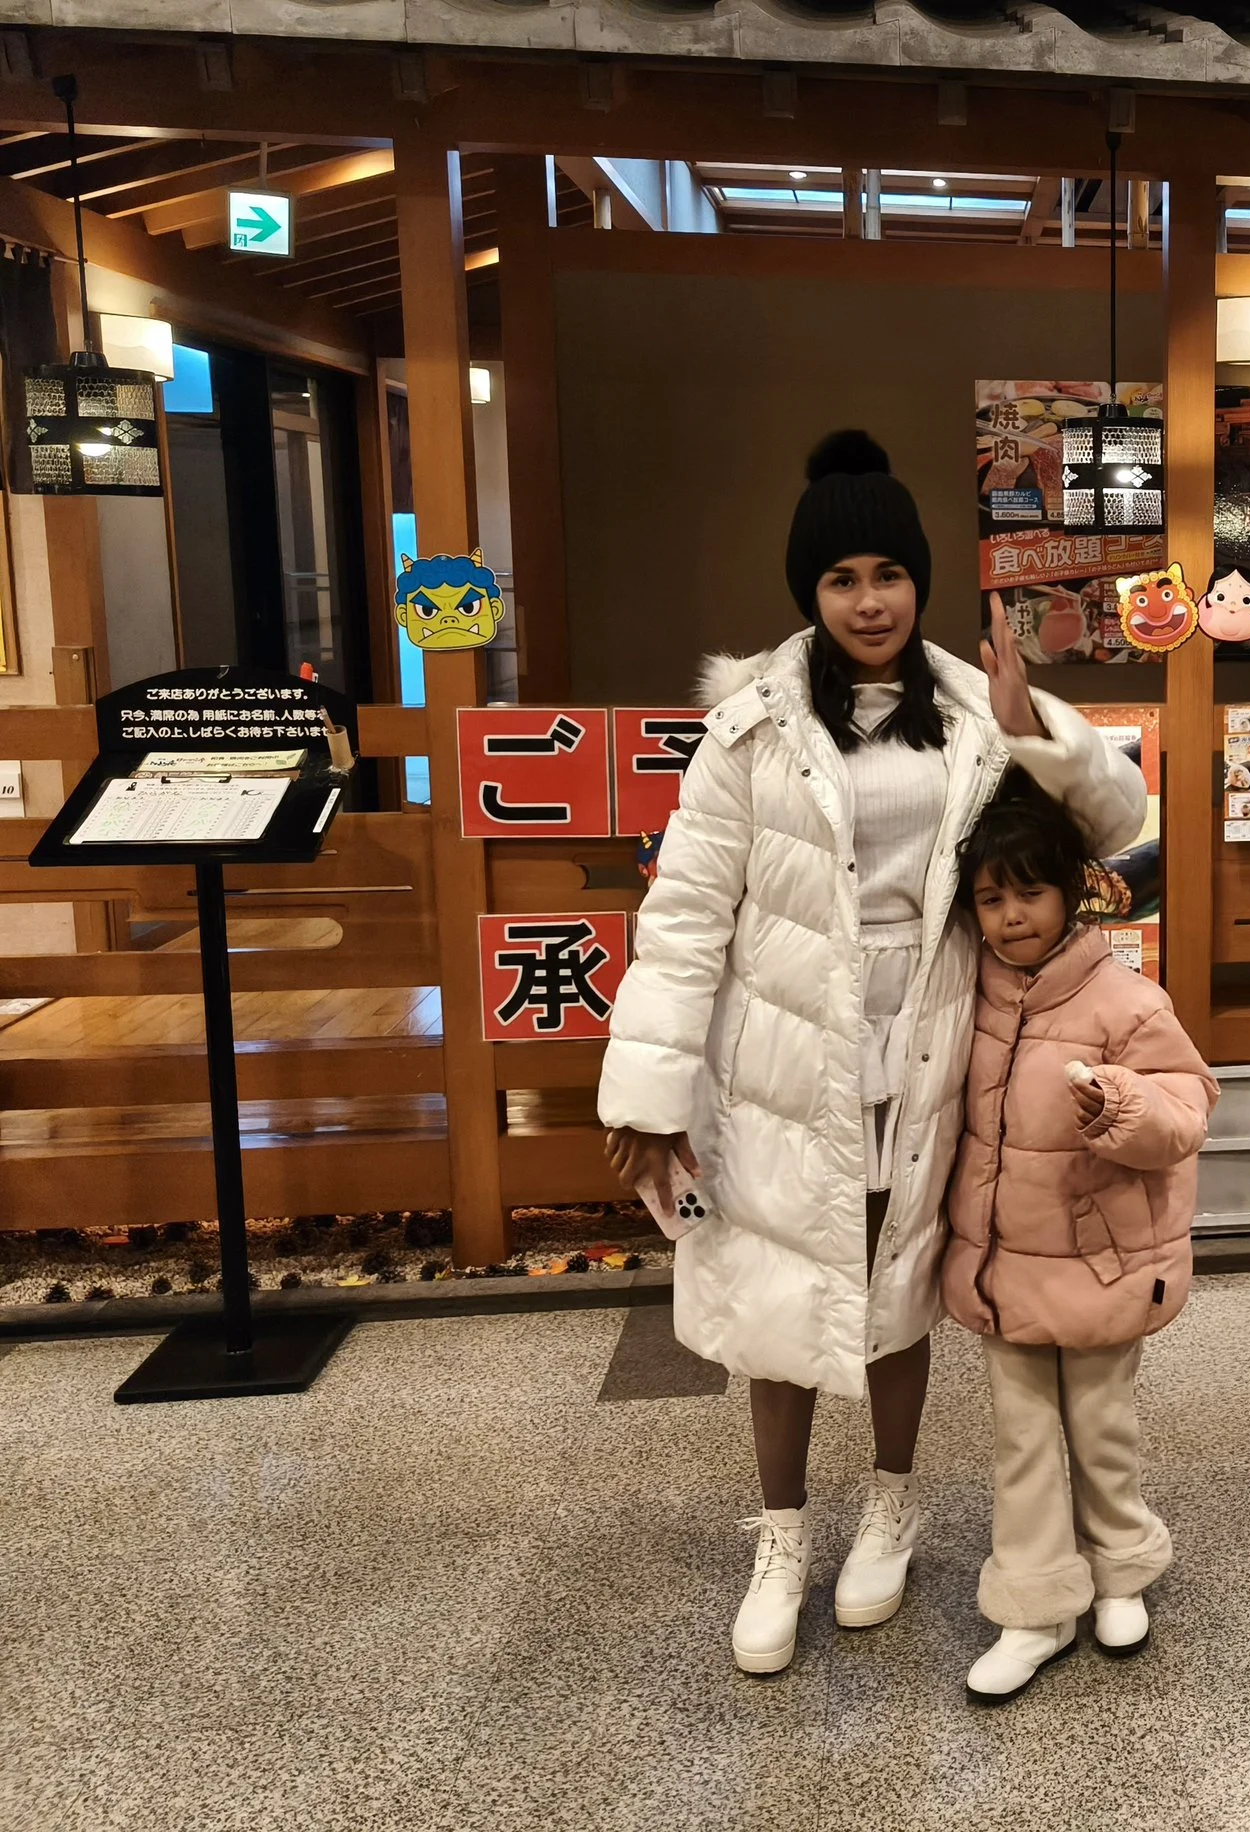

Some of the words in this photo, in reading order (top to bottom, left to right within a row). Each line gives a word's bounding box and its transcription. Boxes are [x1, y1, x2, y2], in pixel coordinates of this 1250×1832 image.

[990, 402, 1021, 463] 焼肉
[990, 535, 1103, 579] 食べ放題
[146, 687, 309, 701] ご来店ありがとうございます。
[121, 709, 200, 722] 只今、満席の為
[2, 785, 15, 795] 10
[495, 920, 614, 1031] 承
